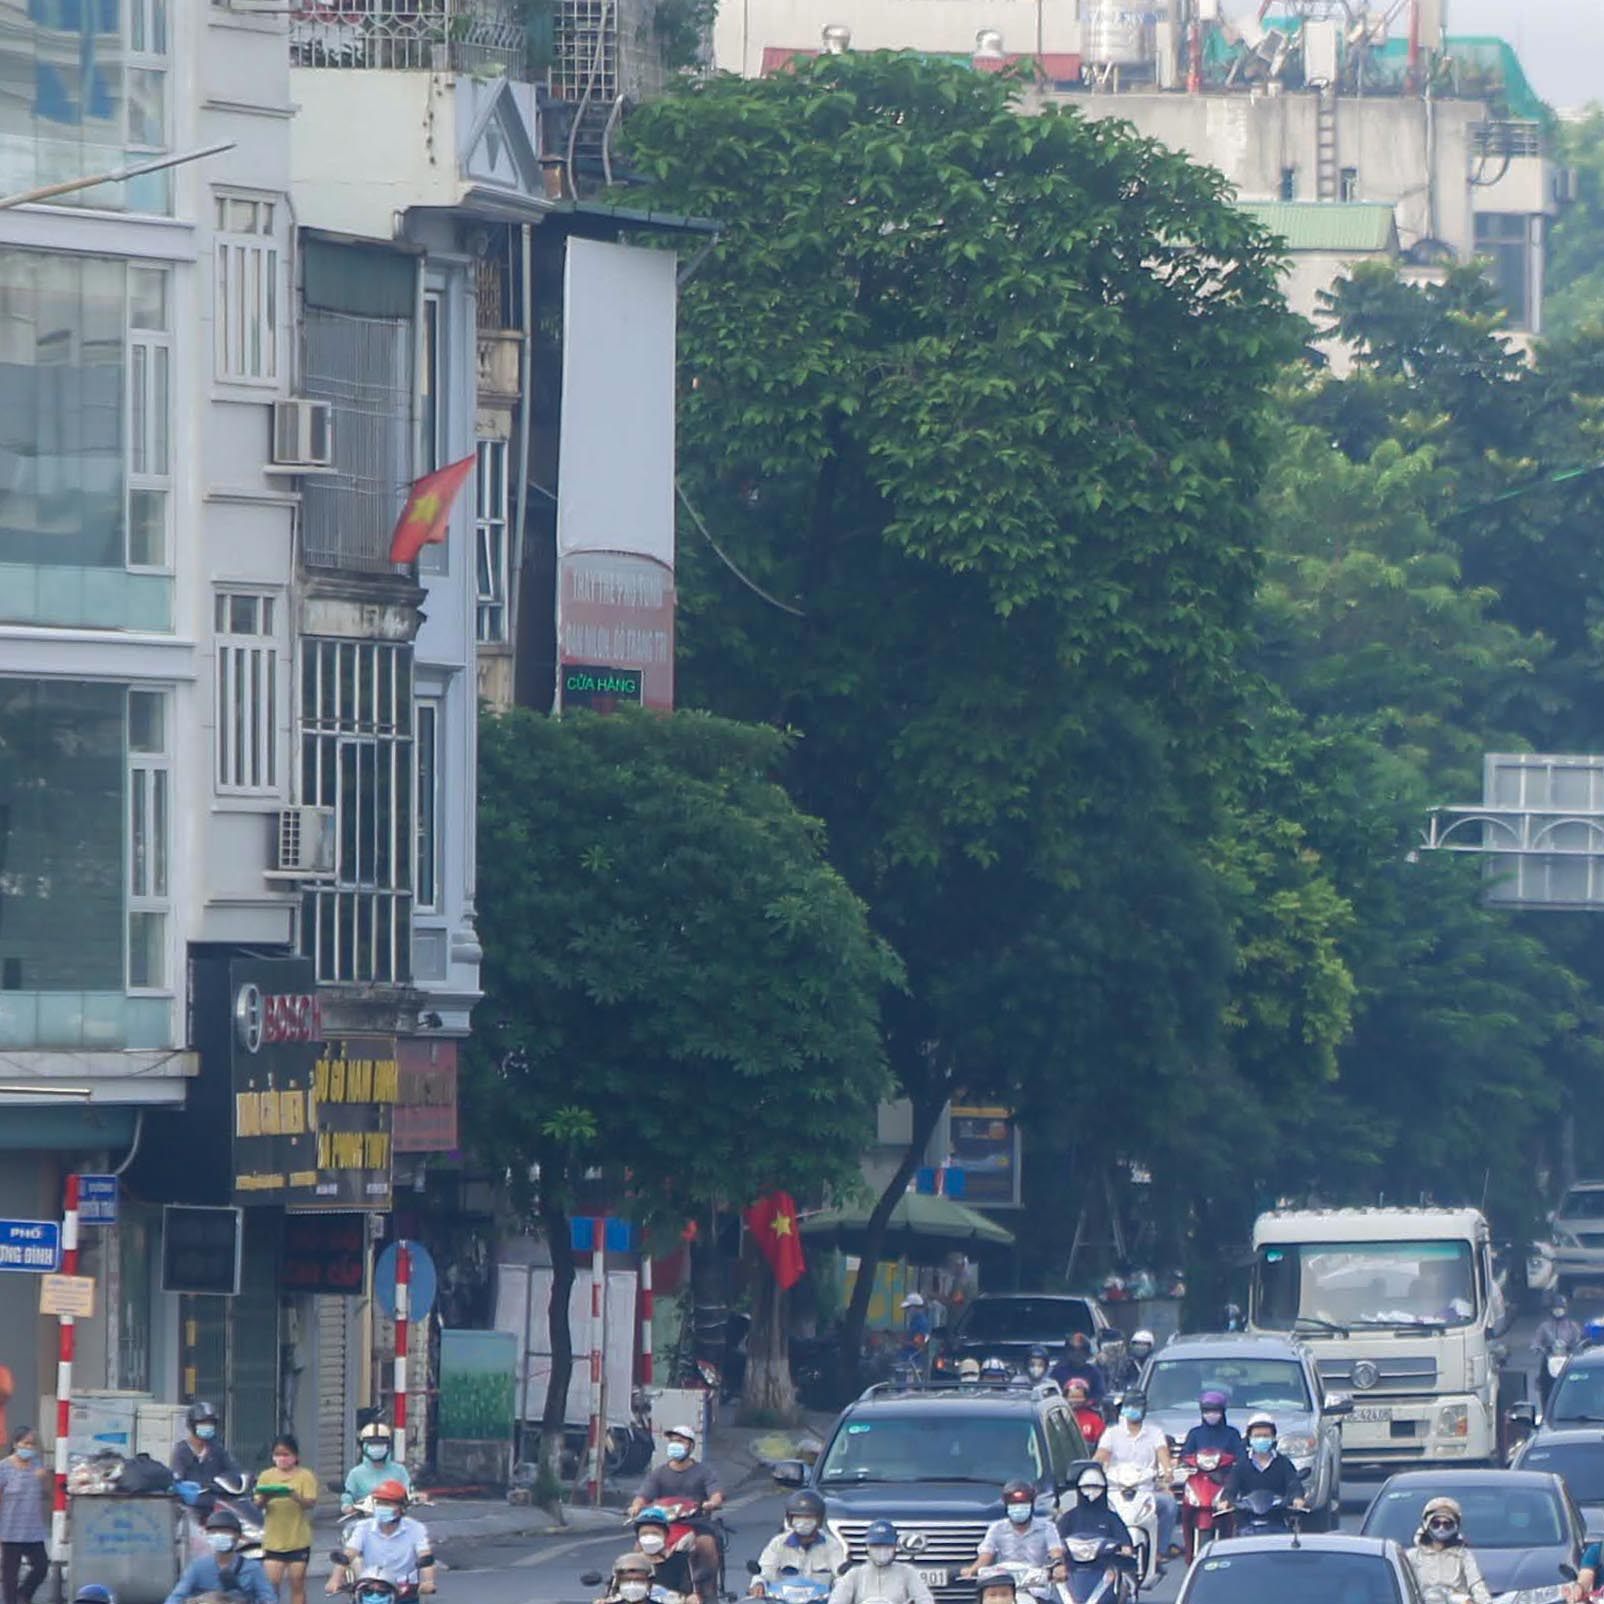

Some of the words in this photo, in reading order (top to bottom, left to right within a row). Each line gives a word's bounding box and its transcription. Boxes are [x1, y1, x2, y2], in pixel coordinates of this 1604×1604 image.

[567, 672, 594, 690] CỬA
[598, 675, 635, 693] HÀNG
[263, 994, 322, 1042] BOSCH
[10, 1223, 42, 1240] PHỐ
